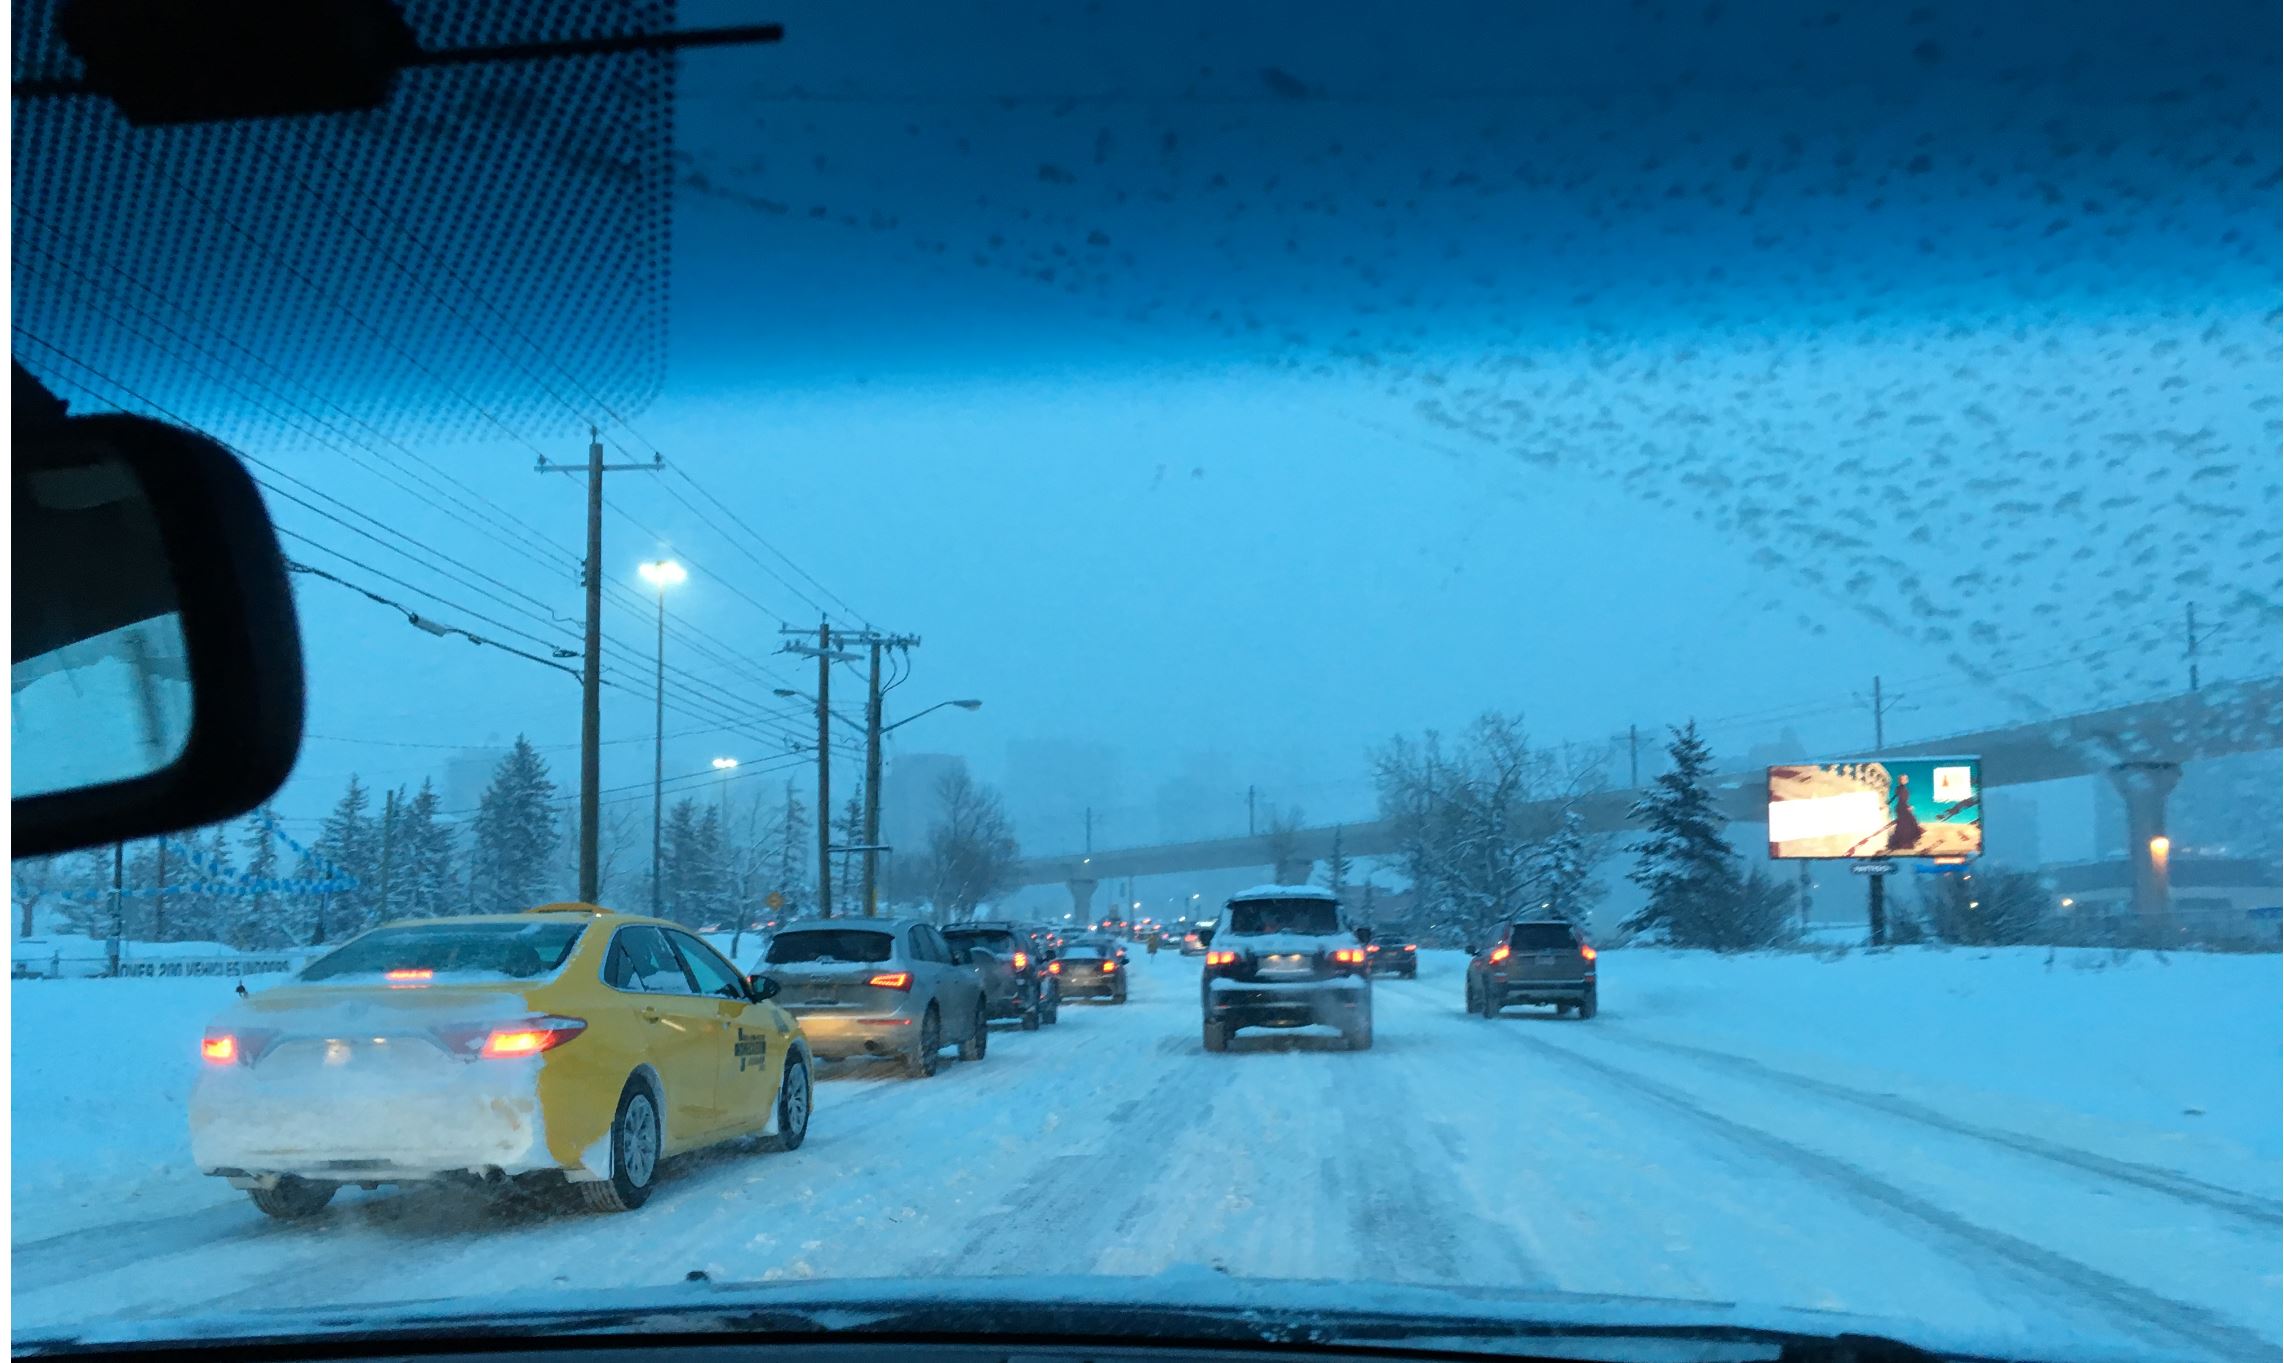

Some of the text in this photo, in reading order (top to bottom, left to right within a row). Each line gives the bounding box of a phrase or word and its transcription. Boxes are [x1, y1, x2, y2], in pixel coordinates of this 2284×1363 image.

[120, 962, 154, 977] OVER
[159, 962, 183, 977] 200
[186, 961, 240, 976] VEHICLES
